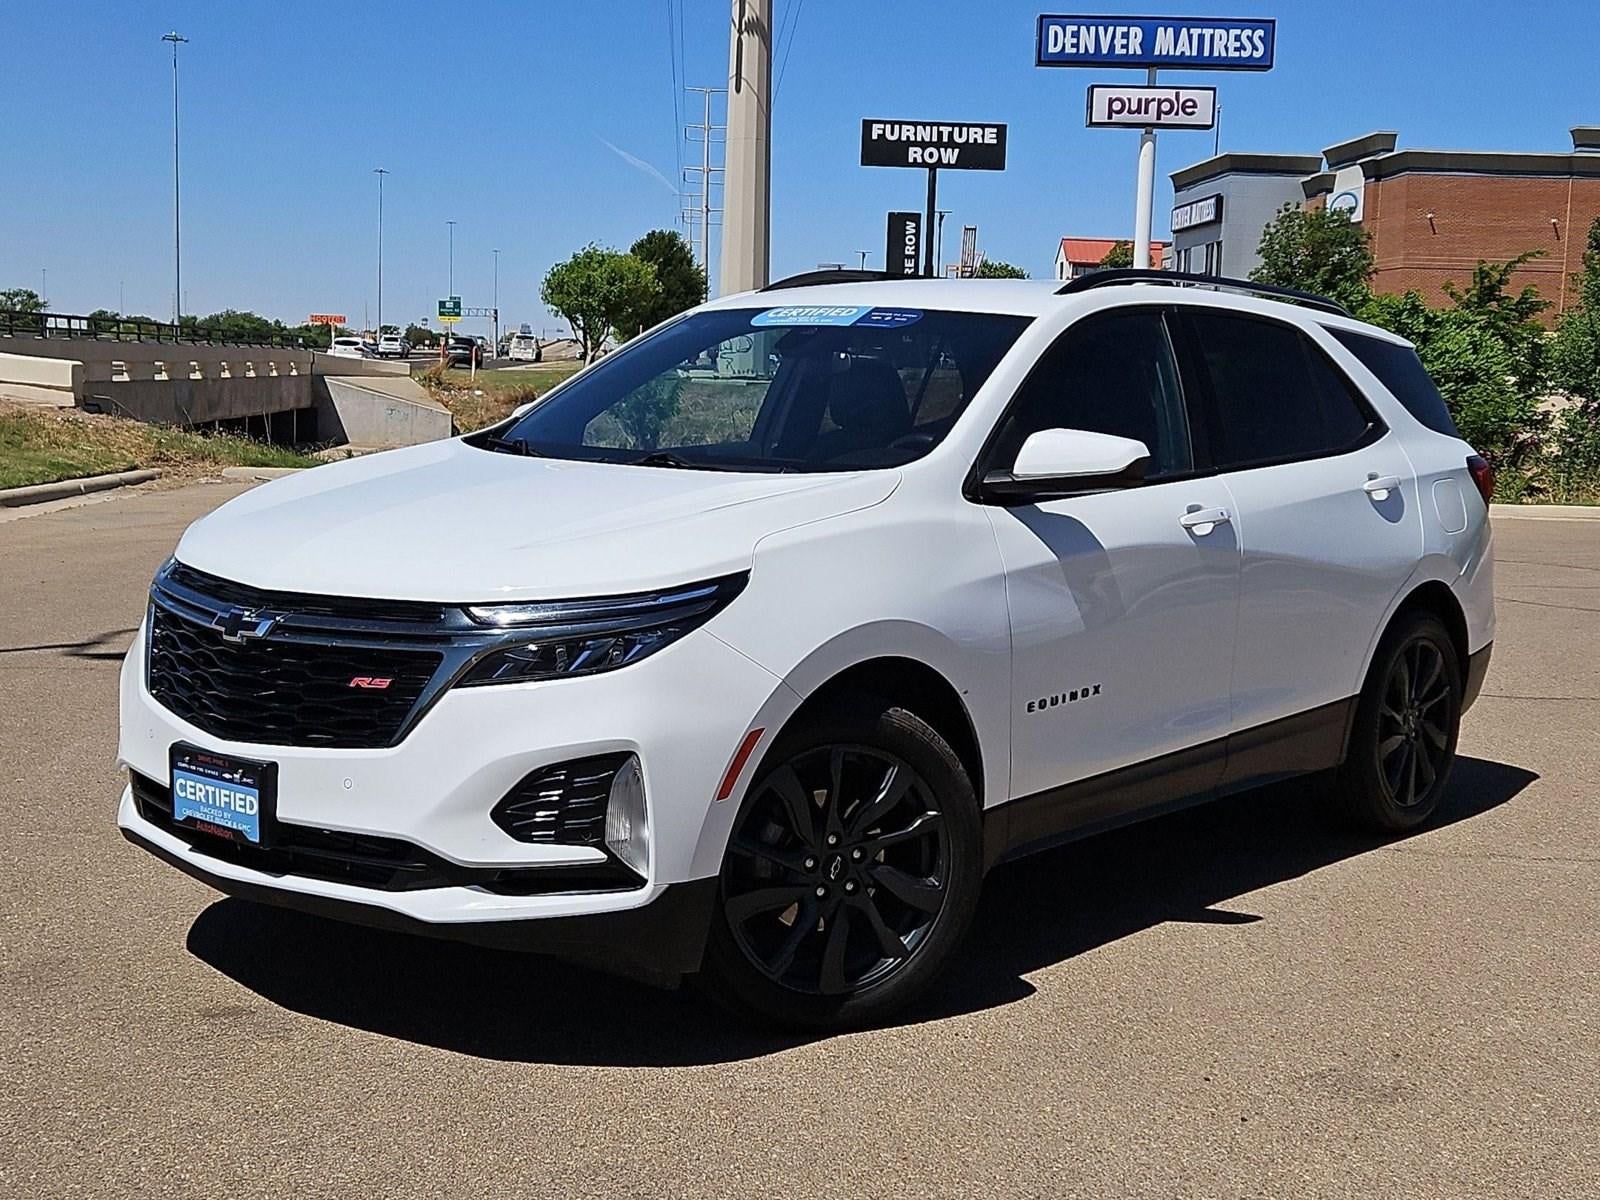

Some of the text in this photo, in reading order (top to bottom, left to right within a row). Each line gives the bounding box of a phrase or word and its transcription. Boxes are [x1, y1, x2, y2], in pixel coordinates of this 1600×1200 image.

[1047, 24, 1265, 58] DENVER MATTRESS
[1106, 91, 1199, 121] purple
[871, 123, 998, 145] FURNITURE
[907, 146, 960, 165] ROW
[904, 221, 917, 256] ROW
[766, 307, 859, 317] CERTIFIED
[349, 677, 392, 689] RS
[1026, 683, 1102, 714] EQUINOX
[175, 778, 257, 815] CERTIFIED
